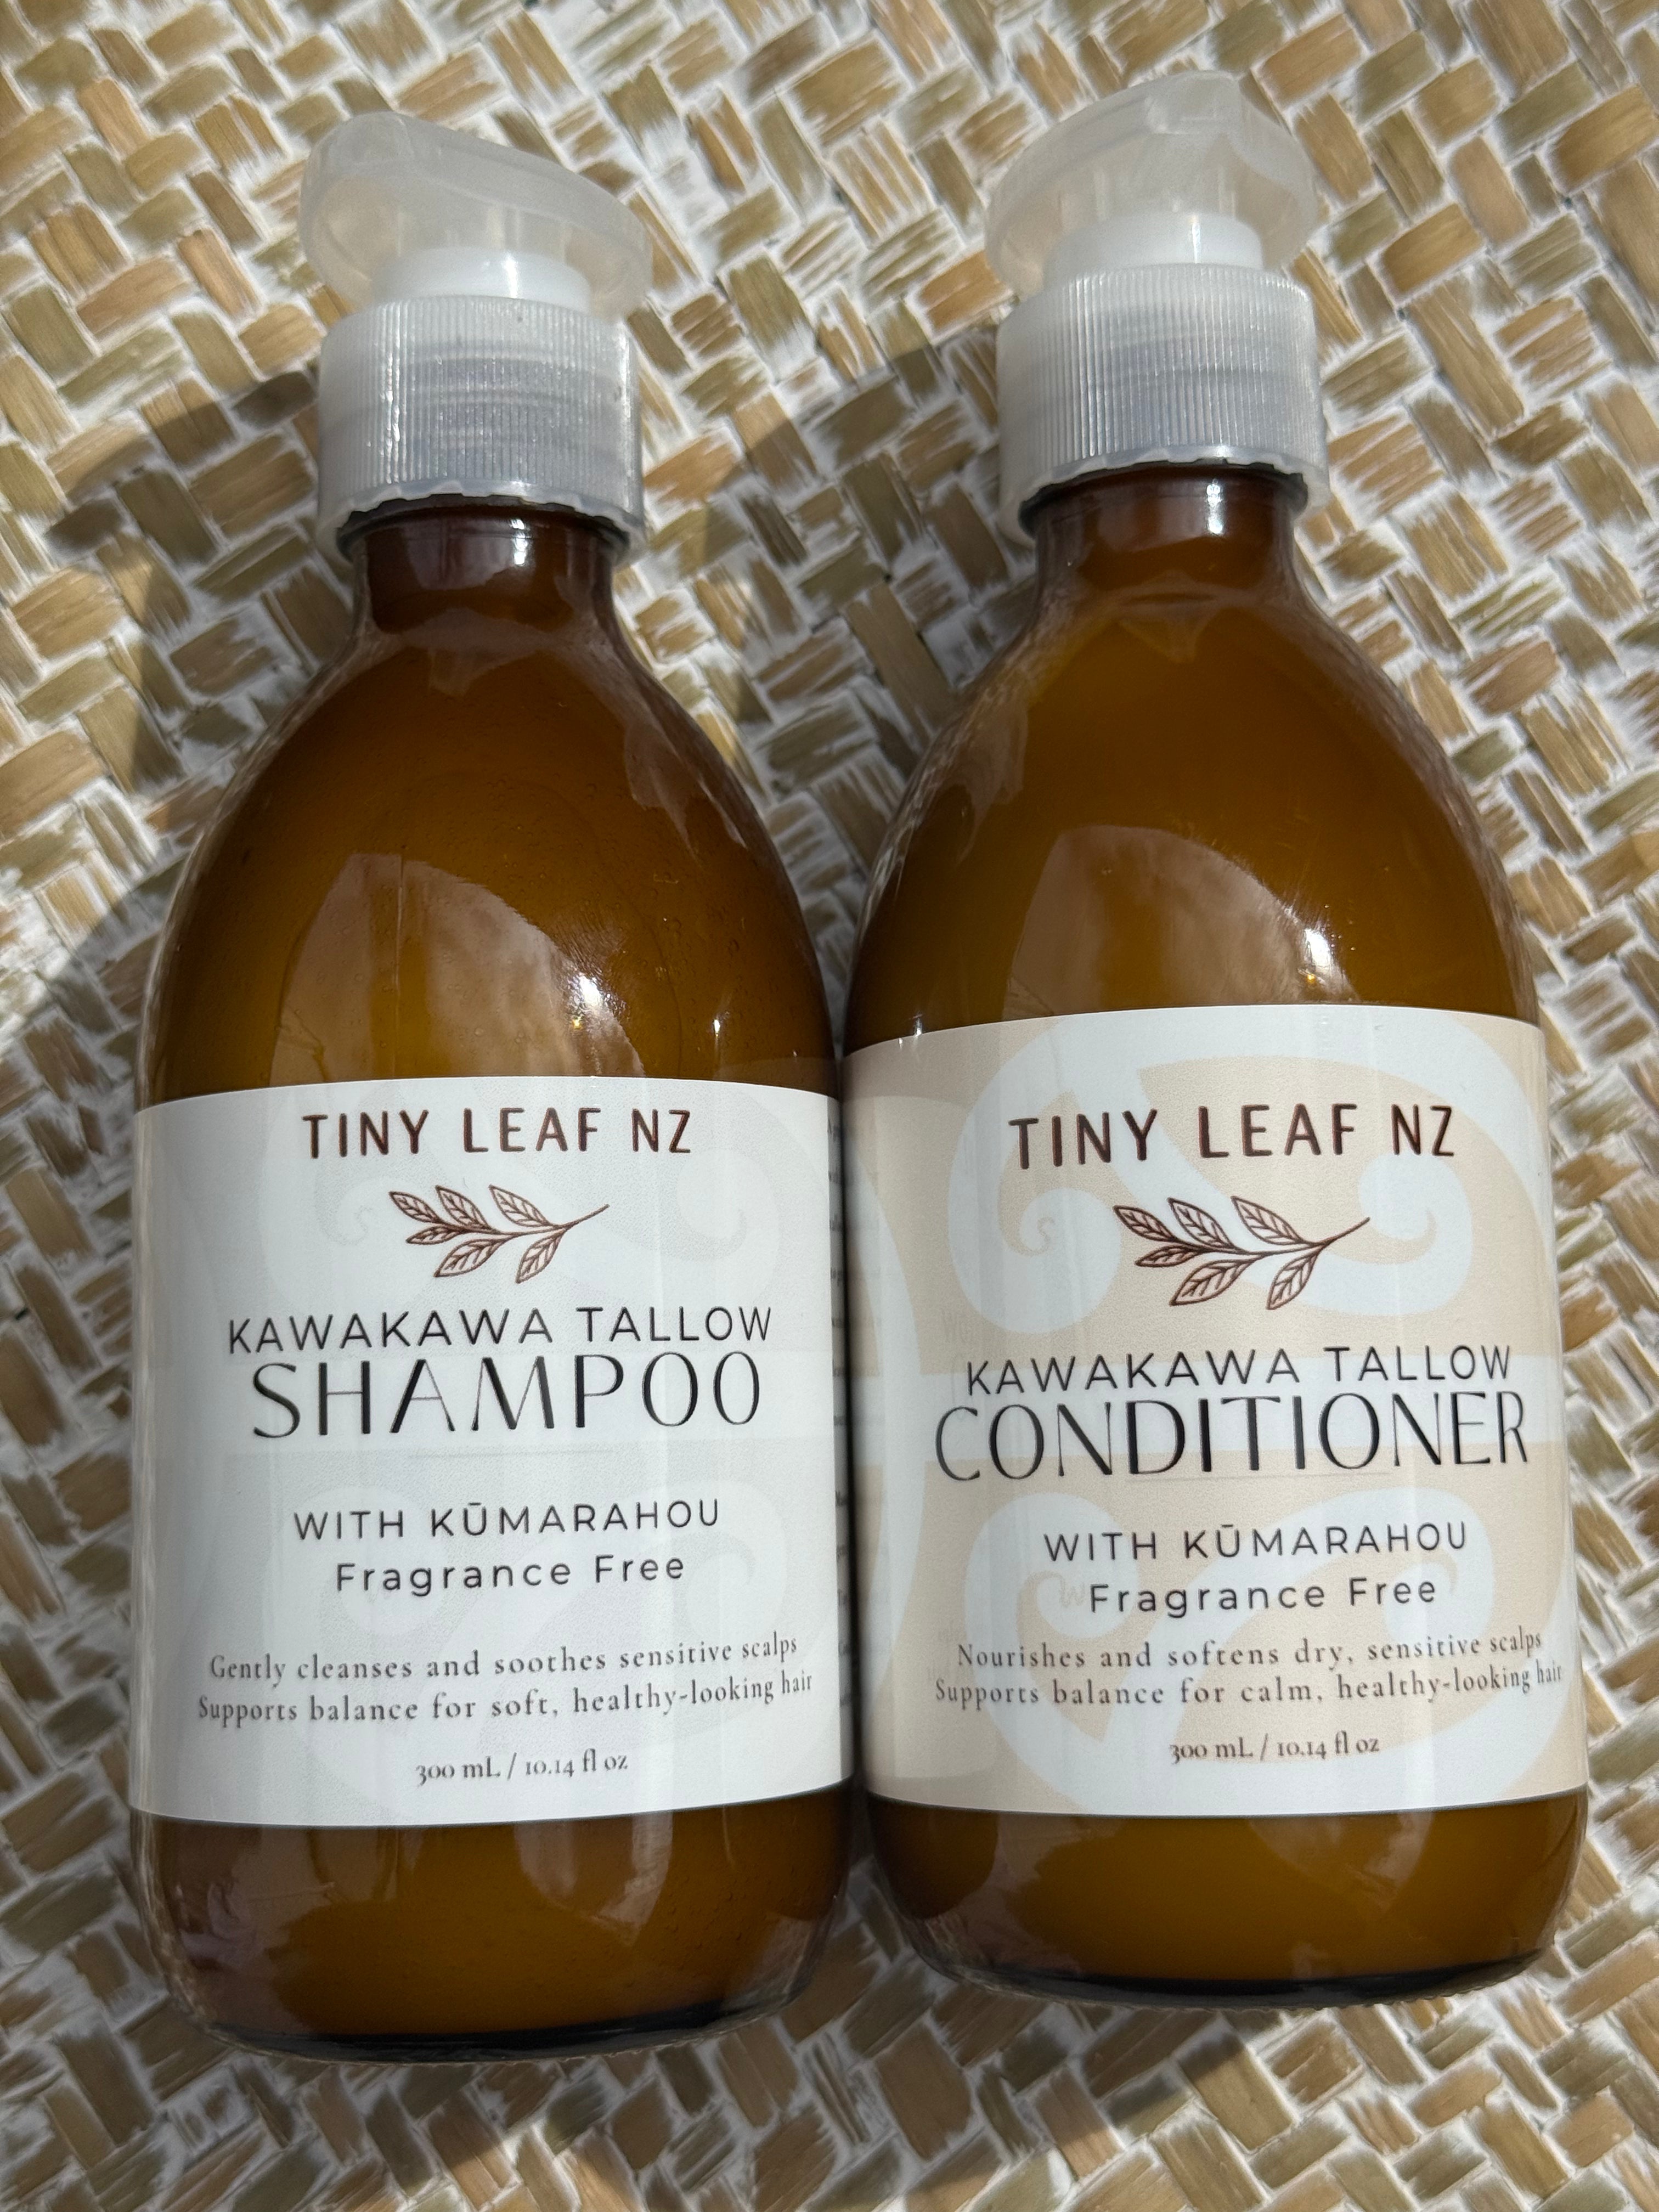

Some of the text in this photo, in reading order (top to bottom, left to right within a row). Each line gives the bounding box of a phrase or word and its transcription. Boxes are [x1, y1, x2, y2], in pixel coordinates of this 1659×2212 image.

[301, 1107, 692, 1160] TINY LEAF NZ
[1008, 1102, 1455, 1170] TINY LEAF NZ
[229, 1306, 772, 1355] KAWAKAWA TALLOW
[252, 1350, 760, 1440] SHAMPOO
[967, 1344, 1511, 1397] KAWAKAWA TALLOW
[934, 1390, 1529, 1482] CONDITIONER
[293, 1498, 719, 1541] WITH KŪMARAHOU
[1043, 1521, 1466, 1562] WITH KŪMARAHOU
[336, 1554, 684, 1599] Fragrance Free
[1090, 1576, 1436, 1620] Fragrance Free
[210, 1630, 797, 1688] Gently cleanses and soothes sensitive scalps
[958, 1625, 1542, 1672] Nourishes and softens dry, sensitive scalps
[198, 1669, 814, 1729] Supports balance for soft, healthy-looking hair
[936, 1660, 1564, 1712] Supports balance for calm, healthy-looking hair
[416, 1747, 628, 1786] 300 mL / 10.14 fl oz
[1169, 1730, 1380, 1765] 300 mL / 10.14 fl oz
